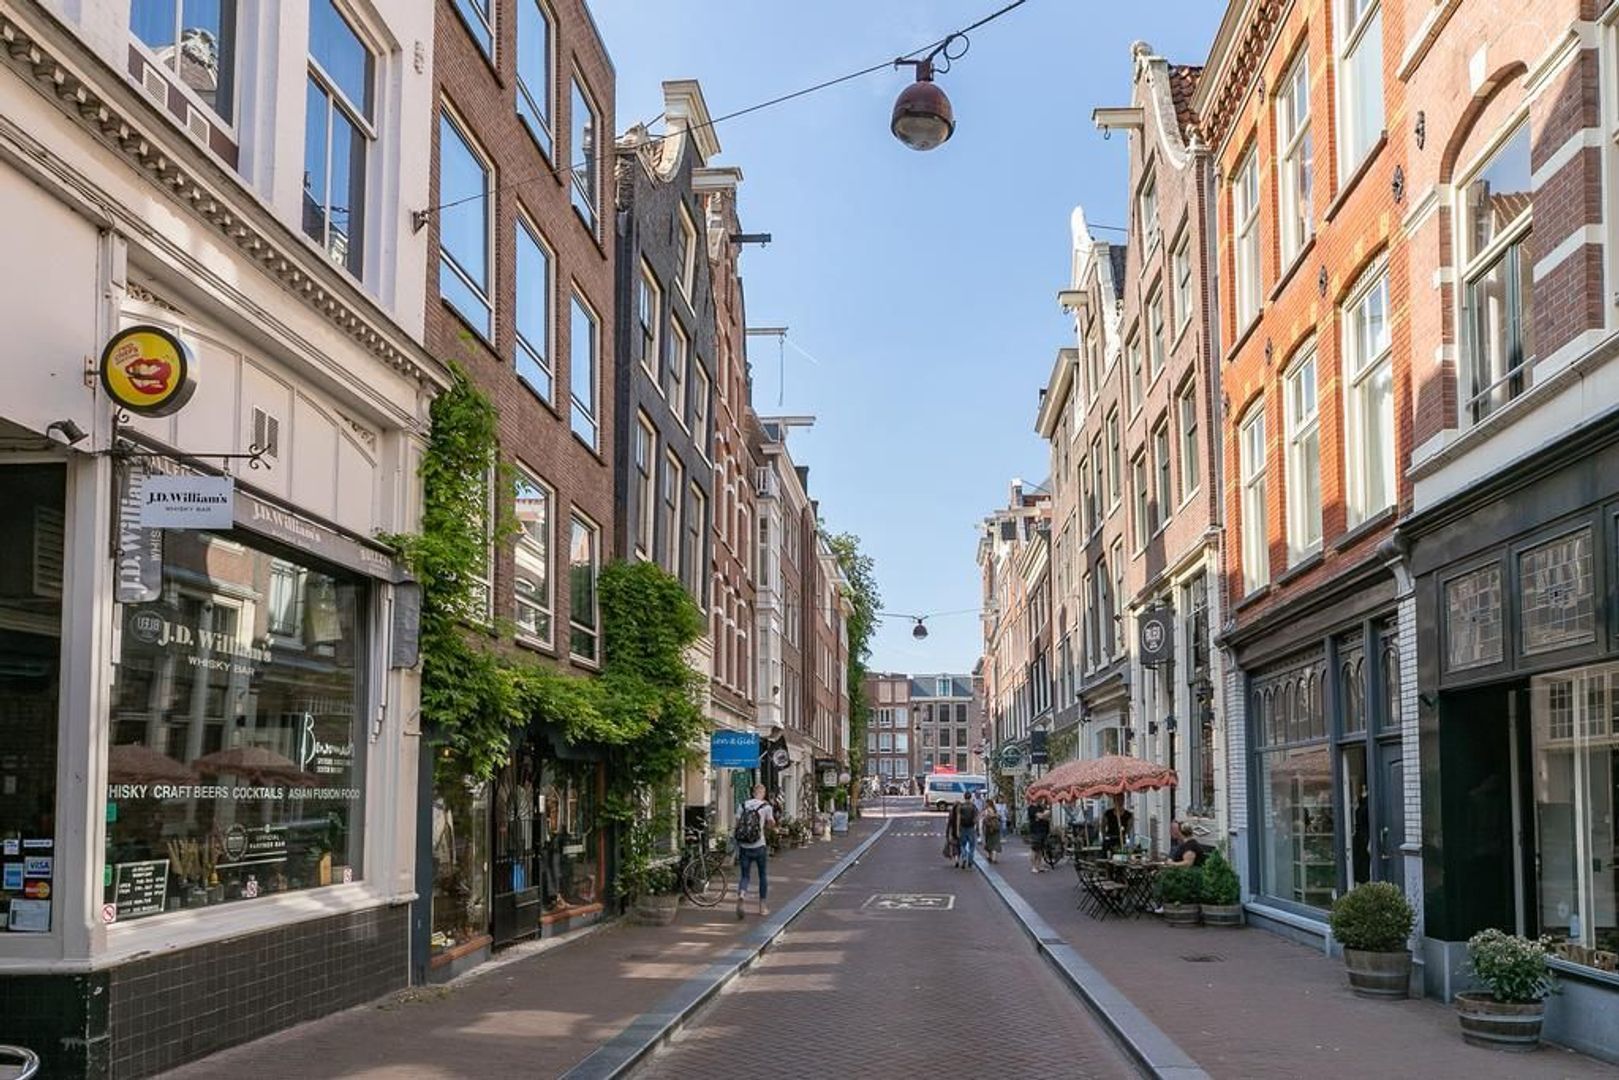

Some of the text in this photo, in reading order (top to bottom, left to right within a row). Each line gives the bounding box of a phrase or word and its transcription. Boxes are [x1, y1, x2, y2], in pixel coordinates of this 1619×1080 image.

[146, 492, 228, 505] J.D. William's
[150, 529, 161, 560] WHIS
[120, 555, 149, 595] J.D.
[157, 621, 195, 646] J.D.
[198, 628, 272, 662] William's
[187, 655, 255, 675] WHISKY BAR
[108, 784, 361, 800] HISKY CRAFT BEERS COCKTAILS ASIAN FUSION FOOD
[30, 861, 50, 869] VISA
